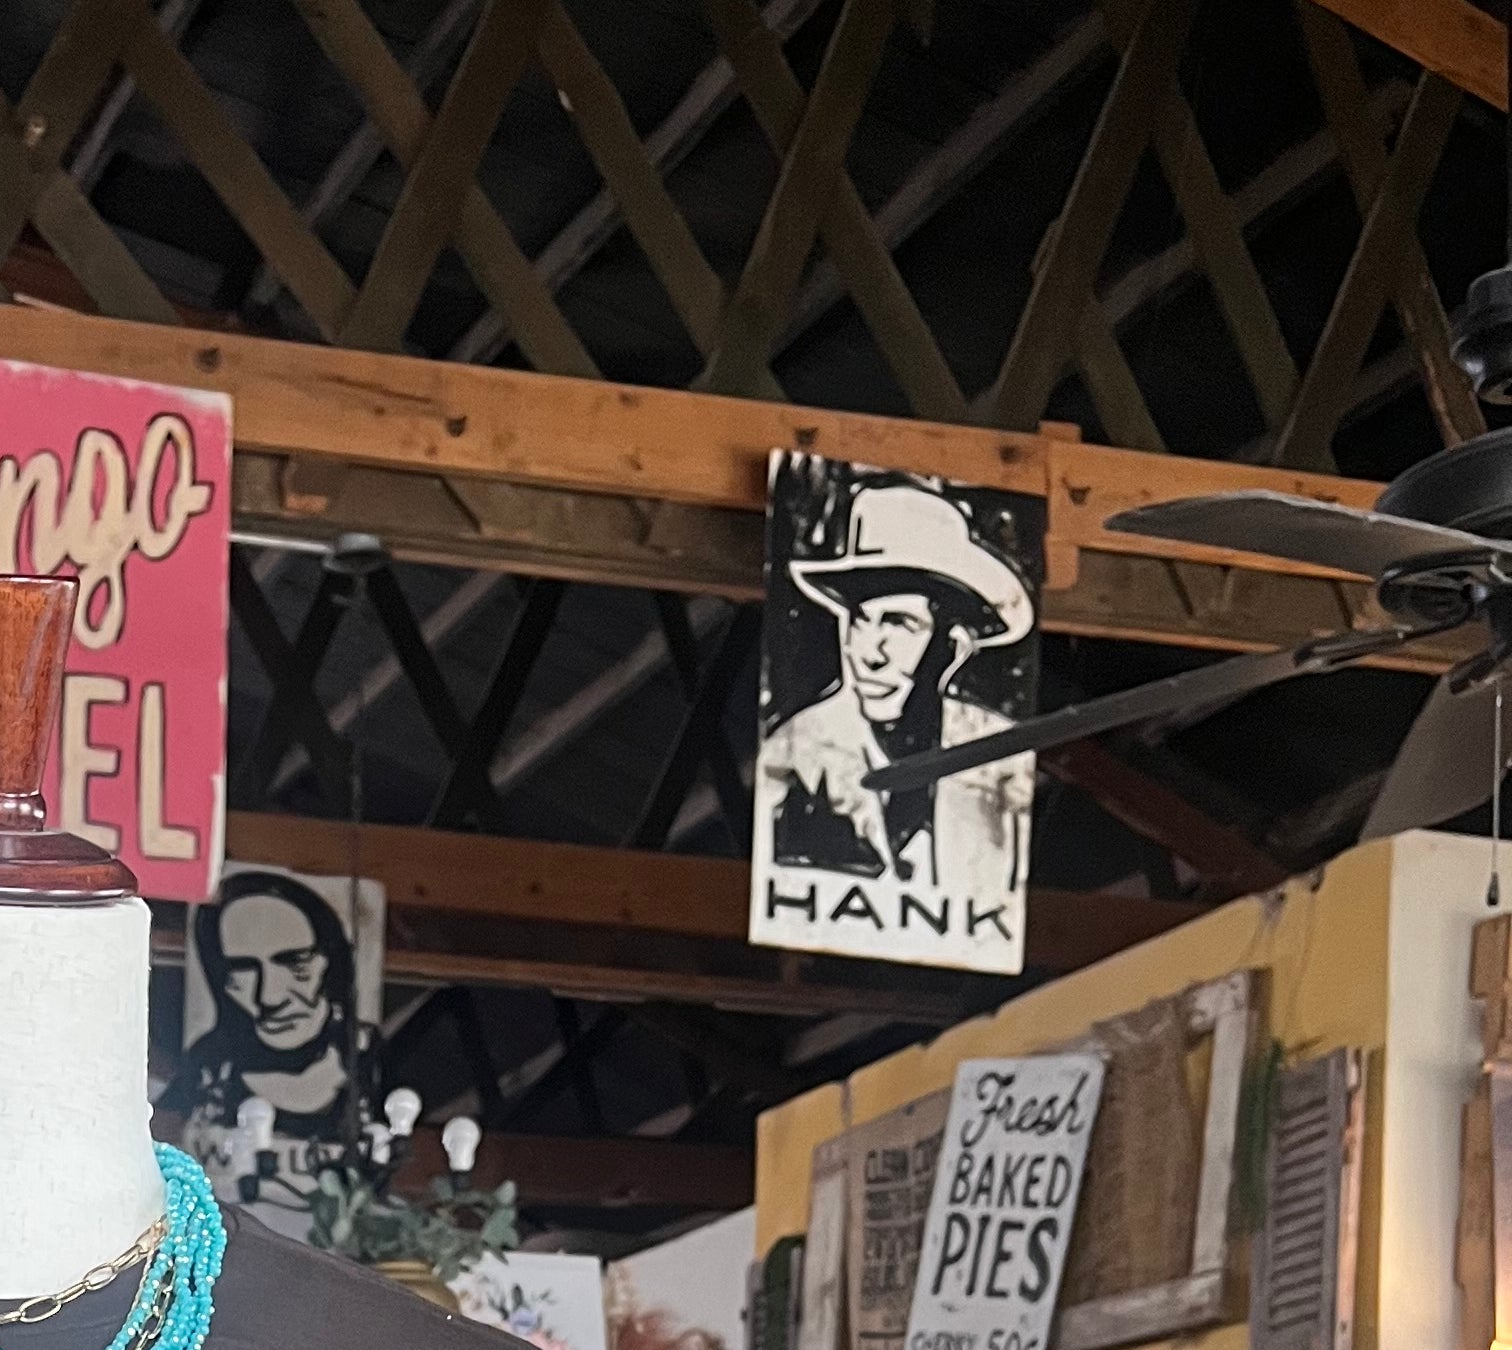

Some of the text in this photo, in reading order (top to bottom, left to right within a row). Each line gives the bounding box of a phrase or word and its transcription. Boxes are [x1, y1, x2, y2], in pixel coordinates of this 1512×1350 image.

[767, 878, 1012, 941] HANK
[960, 1070, 1090, 1148] Fresh
[948, 1152, 1073, 1208] BAKED
[930, 1211, 1060, 1303] PIES
